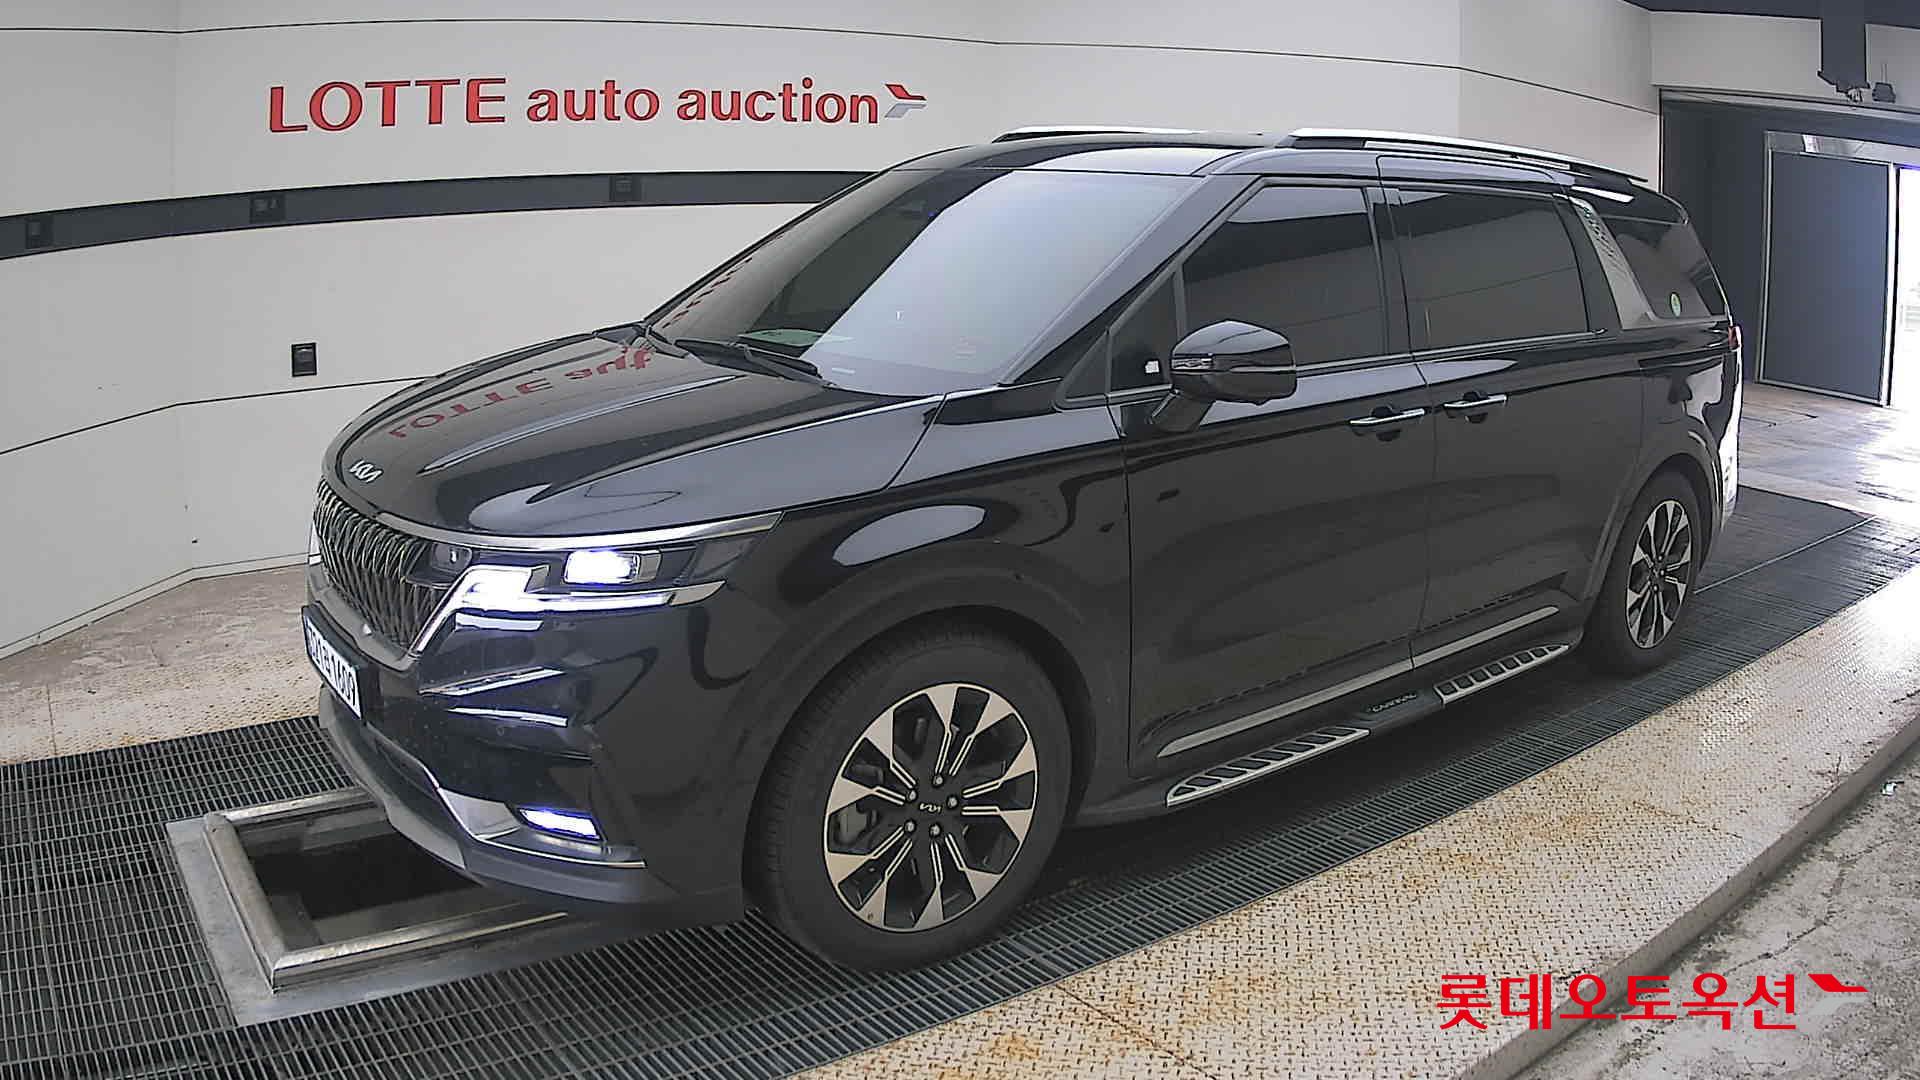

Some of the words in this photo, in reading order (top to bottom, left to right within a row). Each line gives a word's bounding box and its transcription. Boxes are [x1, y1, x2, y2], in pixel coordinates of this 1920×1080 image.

[269, 78, 506, 133] LOTTE
[526, 80, 660, 123] auto
[675, 79, 879, 124] auction
[349, 459, 383, 483] KIA
